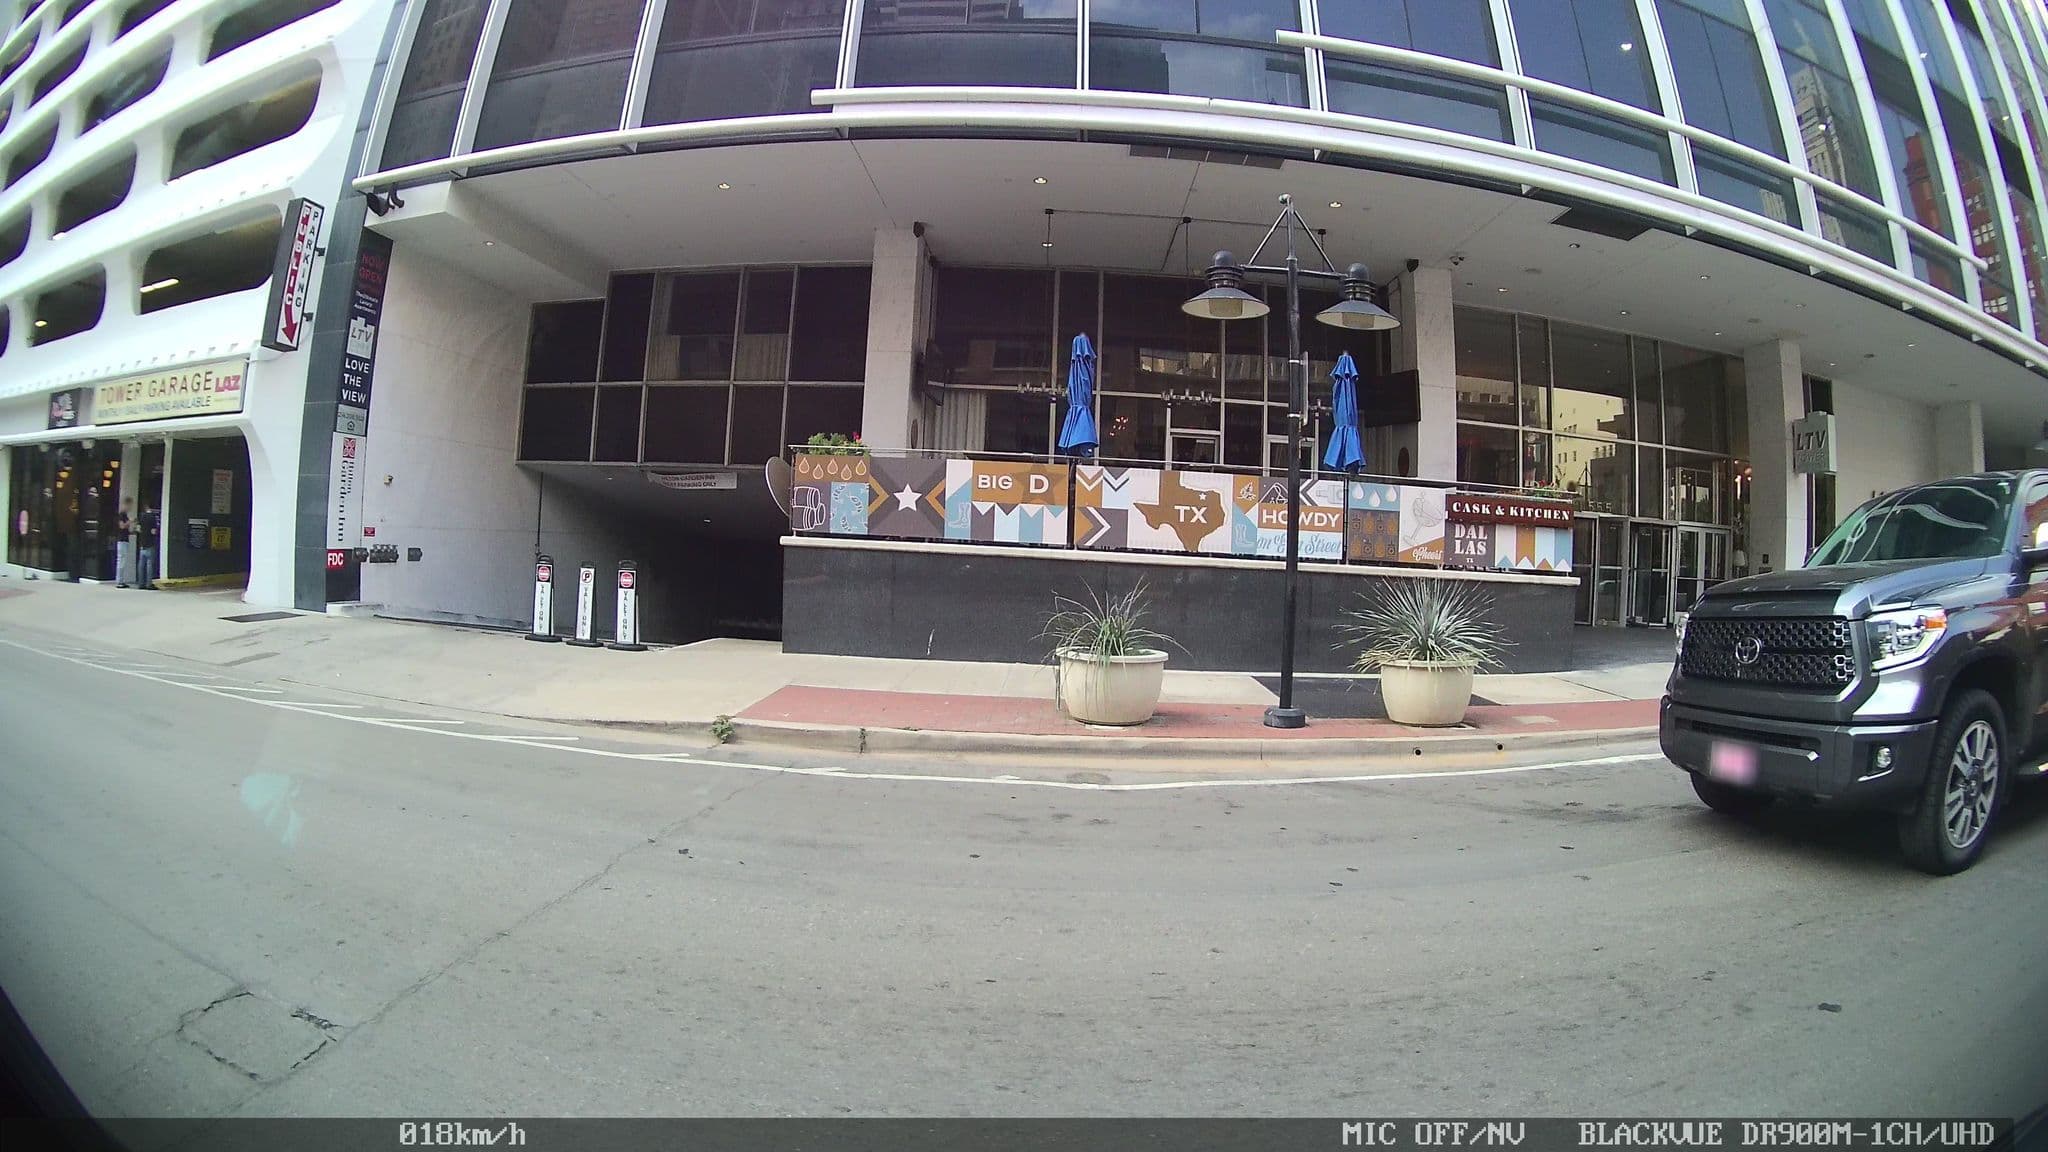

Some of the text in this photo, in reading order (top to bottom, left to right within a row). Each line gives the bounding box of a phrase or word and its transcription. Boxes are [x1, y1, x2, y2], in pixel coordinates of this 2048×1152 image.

[286, 206, 311, 305] PUBLIC
[295, 211, 318, 307] PARKING
[351, 327, 373, 342] LTV
[345, 358, 370, 374] LOVE
[101, 370, 213, 404] TOWER GARAGE
[215, 375, 240, 392] LAZ
[343, 374, 362, 388] THE
[342, 389, 367, 404] VIEW
[1796, 430, 1826, 450] LTV
[978, 474, 1050, 494] BIG D
[1174, 505, 1207, 524] TX
[1262, 509, 1341, 528] HOWDY
[1452, 501, 1570, 521] CASK & KITCHEN
[1454, 523, 1488, 541] DAL
[1304, 533, 1342, 555] Street
[1454, 540, 1487, 556] LAS
[327, 553, 344, 566] FDC
